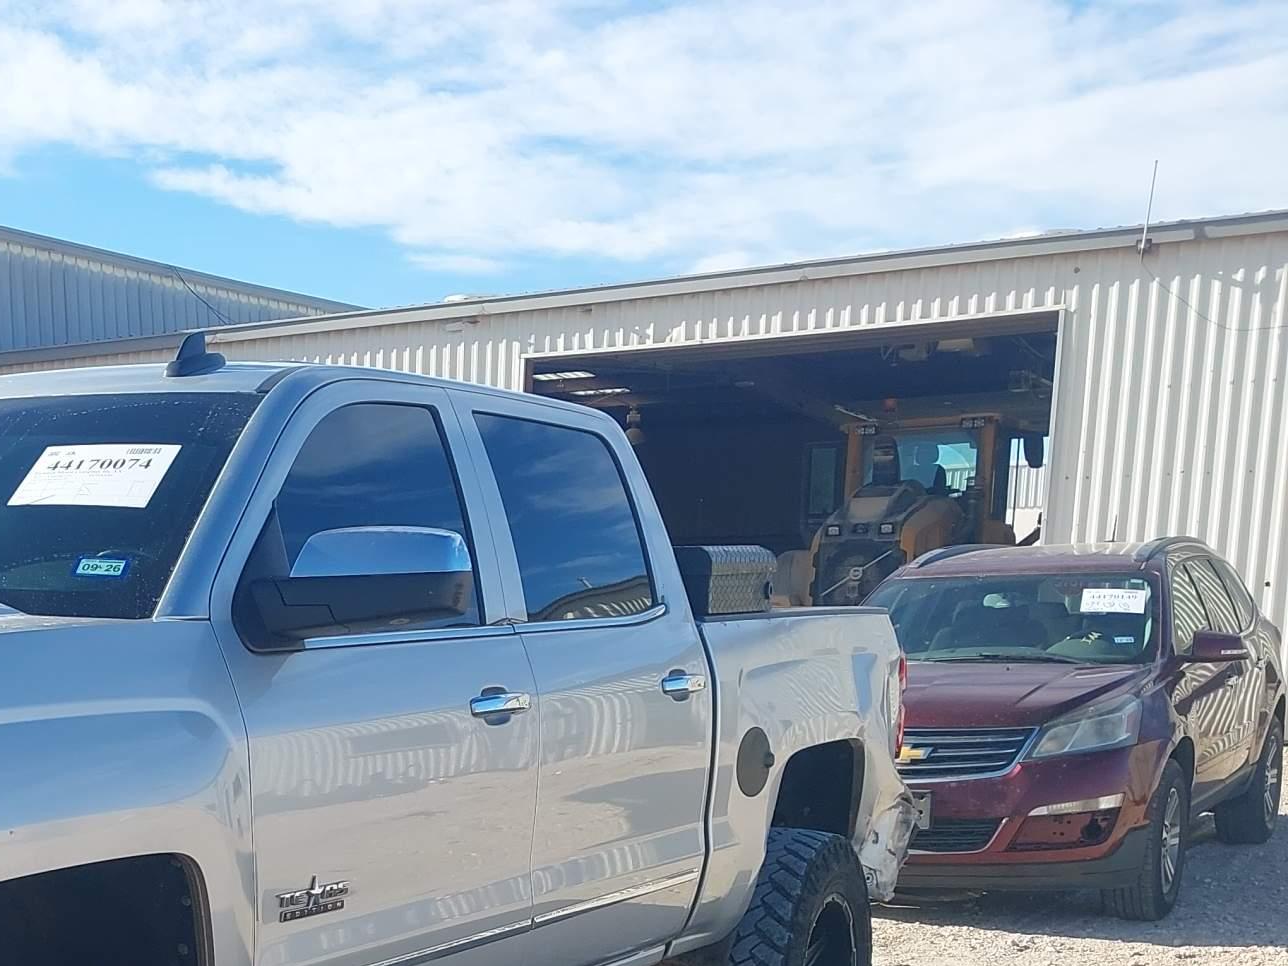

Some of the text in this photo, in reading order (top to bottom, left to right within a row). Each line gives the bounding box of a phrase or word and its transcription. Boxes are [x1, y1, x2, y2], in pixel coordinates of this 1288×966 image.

[47, 457, 154, 471] 44170074
[81, 563, 122, 573] 09 26
[279, 900, 345, 923] EDITION
